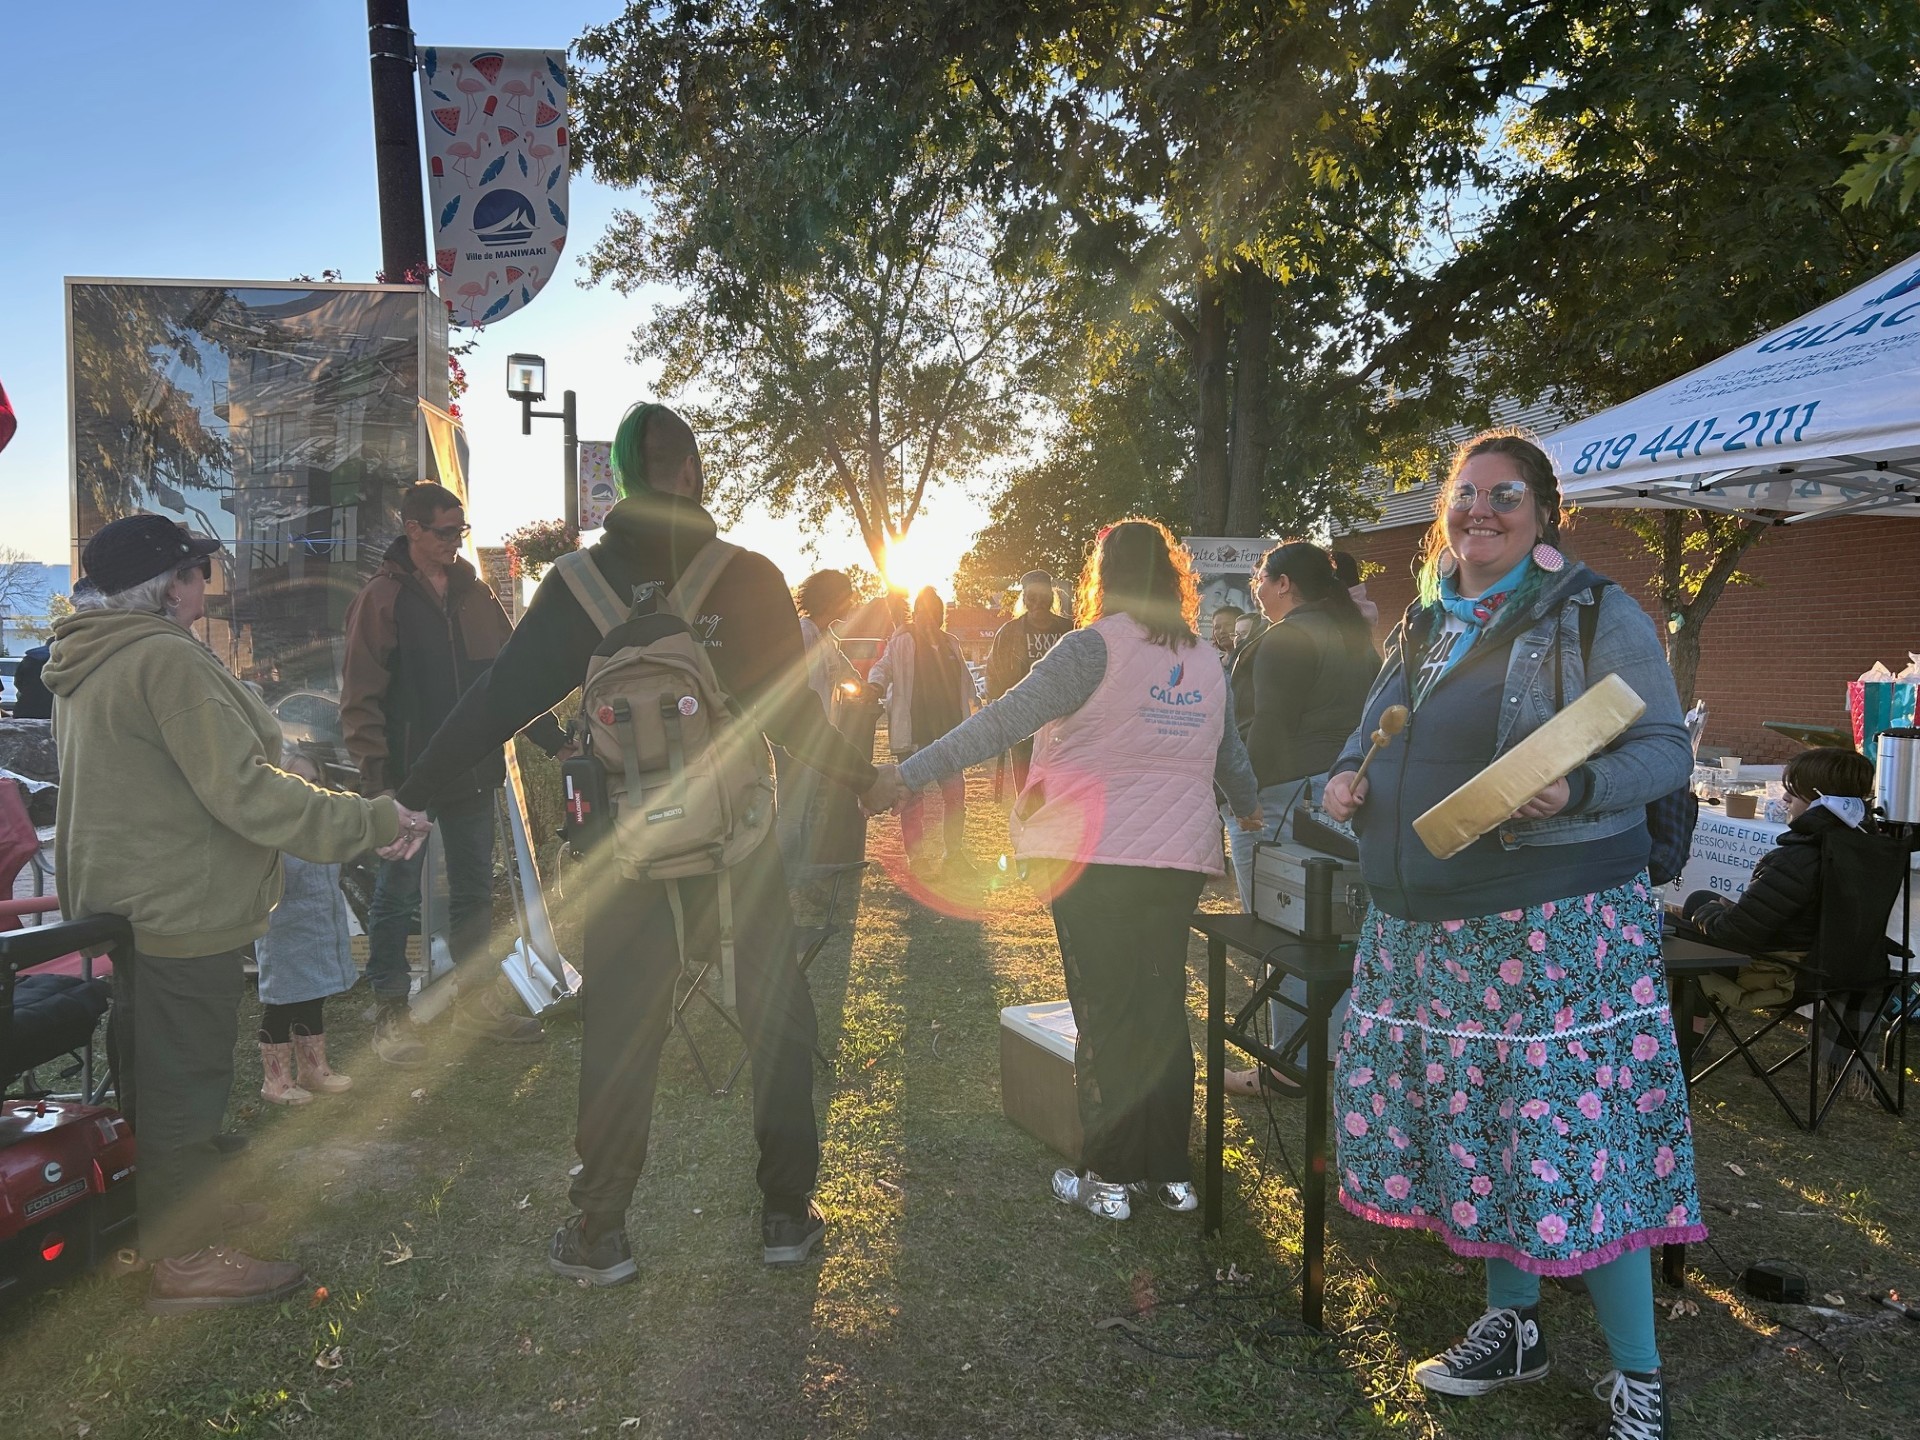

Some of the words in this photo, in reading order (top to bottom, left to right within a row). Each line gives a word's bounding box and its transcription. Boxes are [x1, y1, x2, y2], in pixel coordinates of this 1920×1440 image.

[465, 252, 482, 261] Ville
[484, 252, 493, 260] de
[495, 247, 547, 259] MANIWAKI
[1573, 433, 1637, 475] 819
[1638, 400, 1822, 463] 441-2111
[1190, 547, 1217, 561] alte
[1149, 685, 1203, 706] CALACS
[1701, 821, 1735, 837] D'AIDE
[1737, 828, 1751, 840] ET
[1752, 831, 1767, 845] DE
[1692, 847, 1704, 859] LA
[1739, 842, 1748, 853] À
[1709, 875, 1732, 892] 819
[27, 1182, 84, 1212] FORTRESS
